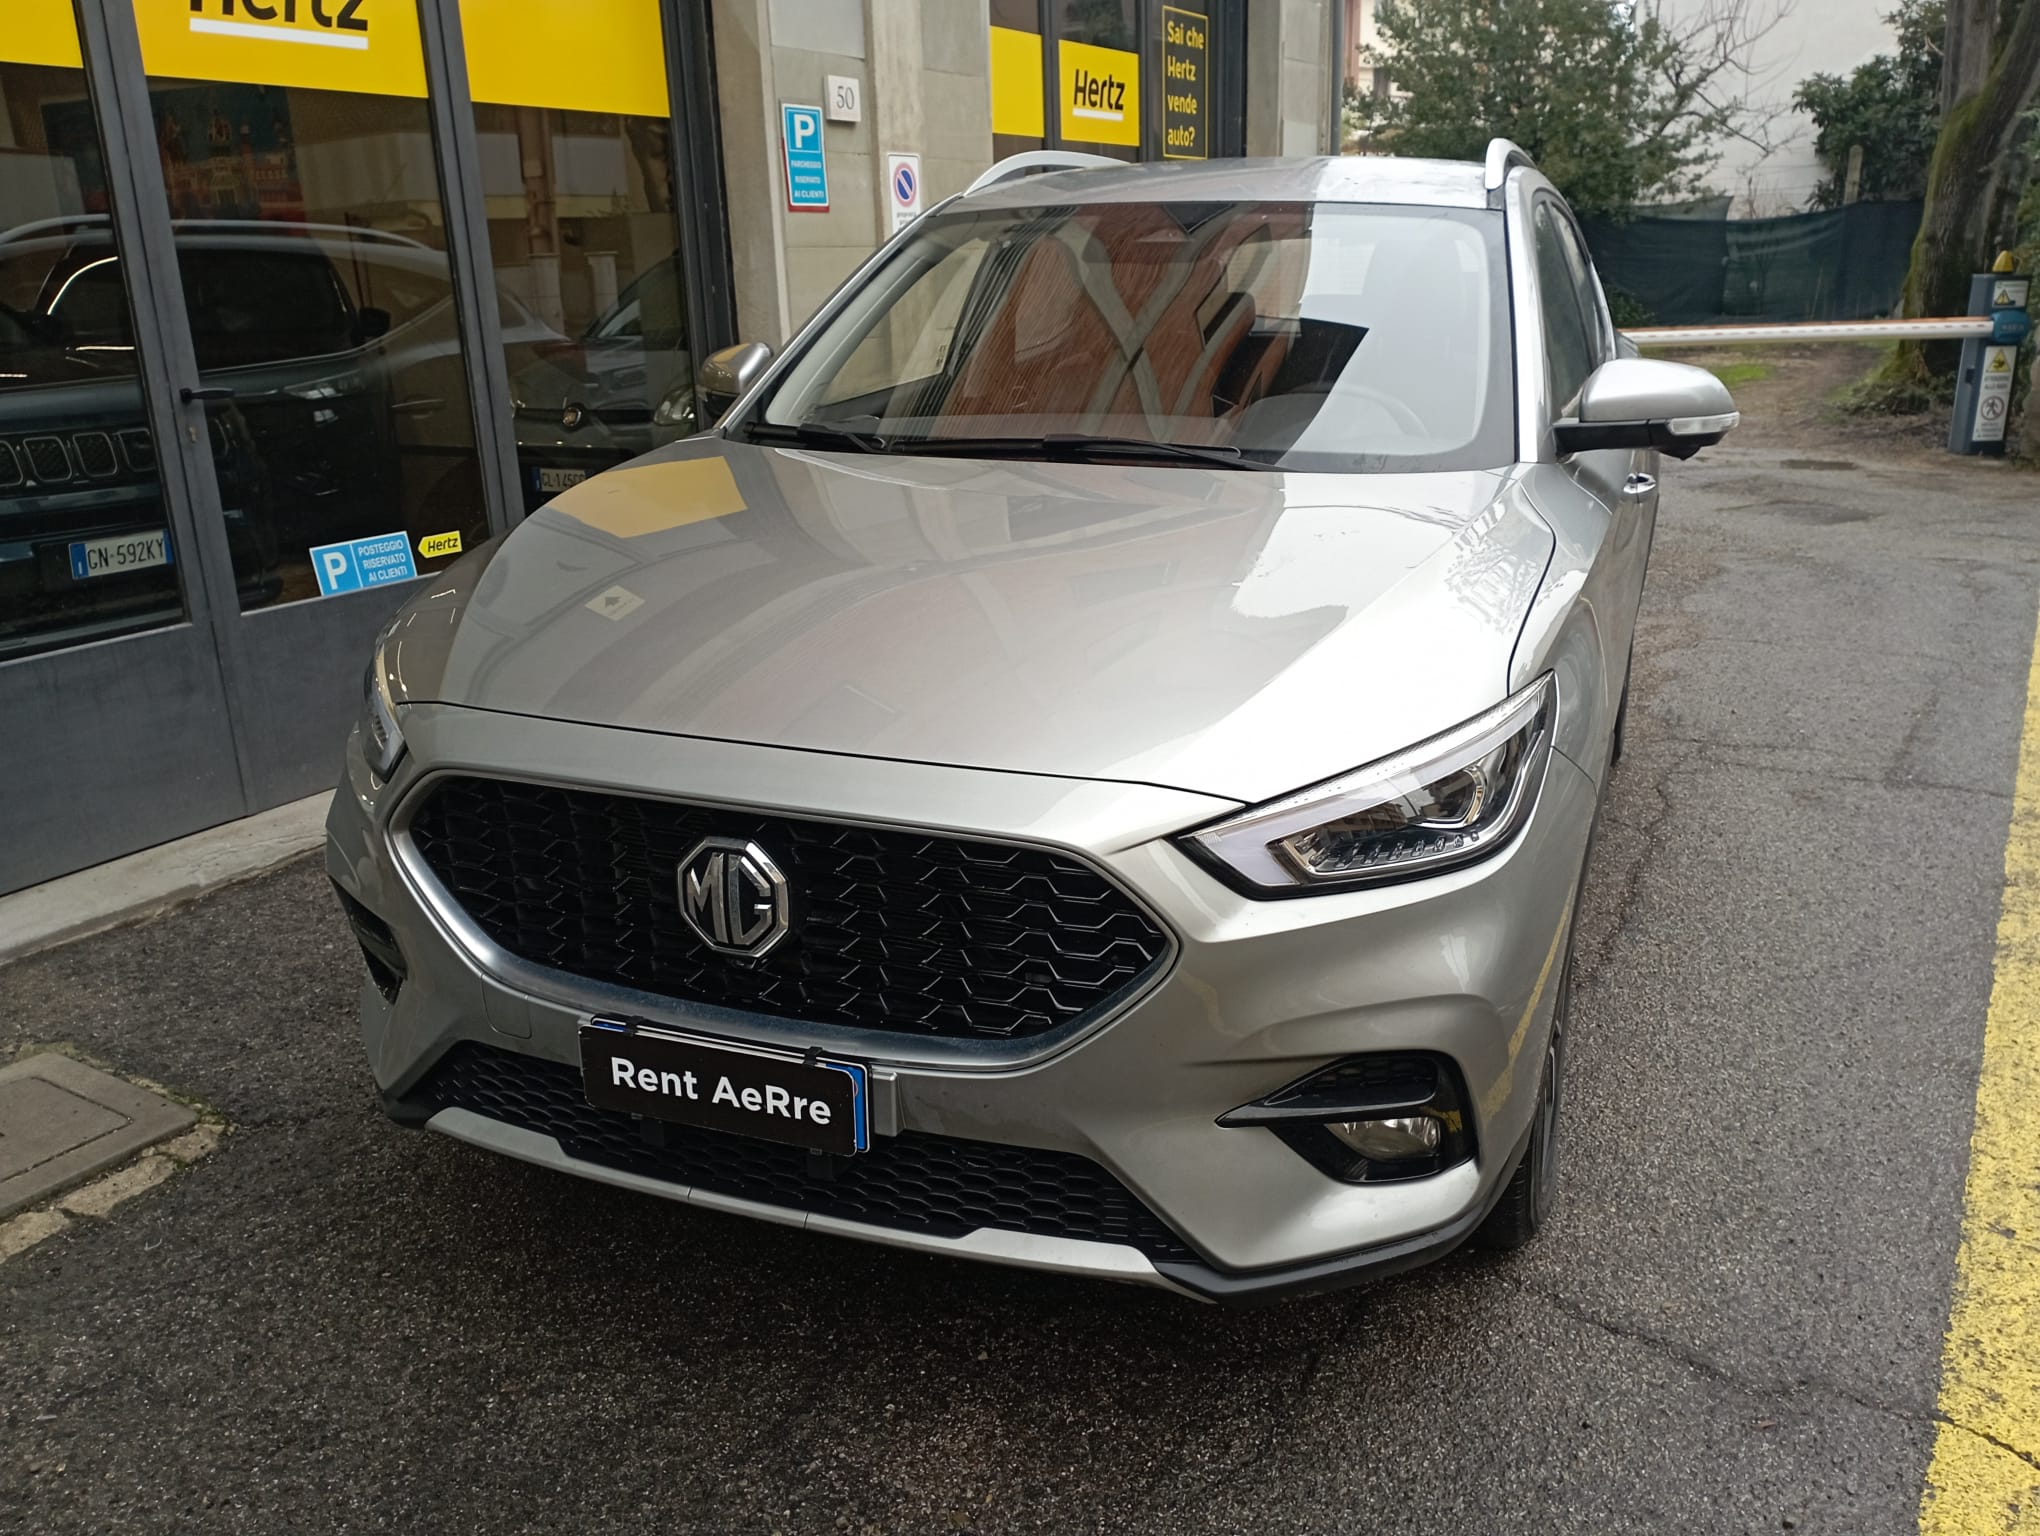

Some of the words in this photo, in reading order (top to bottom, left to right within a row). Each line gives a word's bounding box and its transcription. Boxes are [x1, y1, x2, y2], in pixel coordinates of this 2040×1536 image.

[1167, 20, 1184, 45] Sai
[1186, 26, 1204, 49] che
[1167, 55, 1197, 81] Hertz
[836, 85, 855, 110] 50
[1073, 68, 1126, 111] Hertz
[1167, 93, 1198, 115] vende
[794, 113, 815, 148] P
[1167, 125, 1196, 147] auto?
[358, 539, 404, 557] POSTEGGIO
[427, 537, 459, 552] Hertz
[322, 551, 348, 590] P
[362, 554, 406, 570] RISERVATO
[368, 571, 378, 582] AI
[378, 566, 408, 580] CLIENTI
[686, 851, 773, 946] MG
[611, 1056, 699, 1100] Rent
[712, 1076, 832, 1125] AeRre
